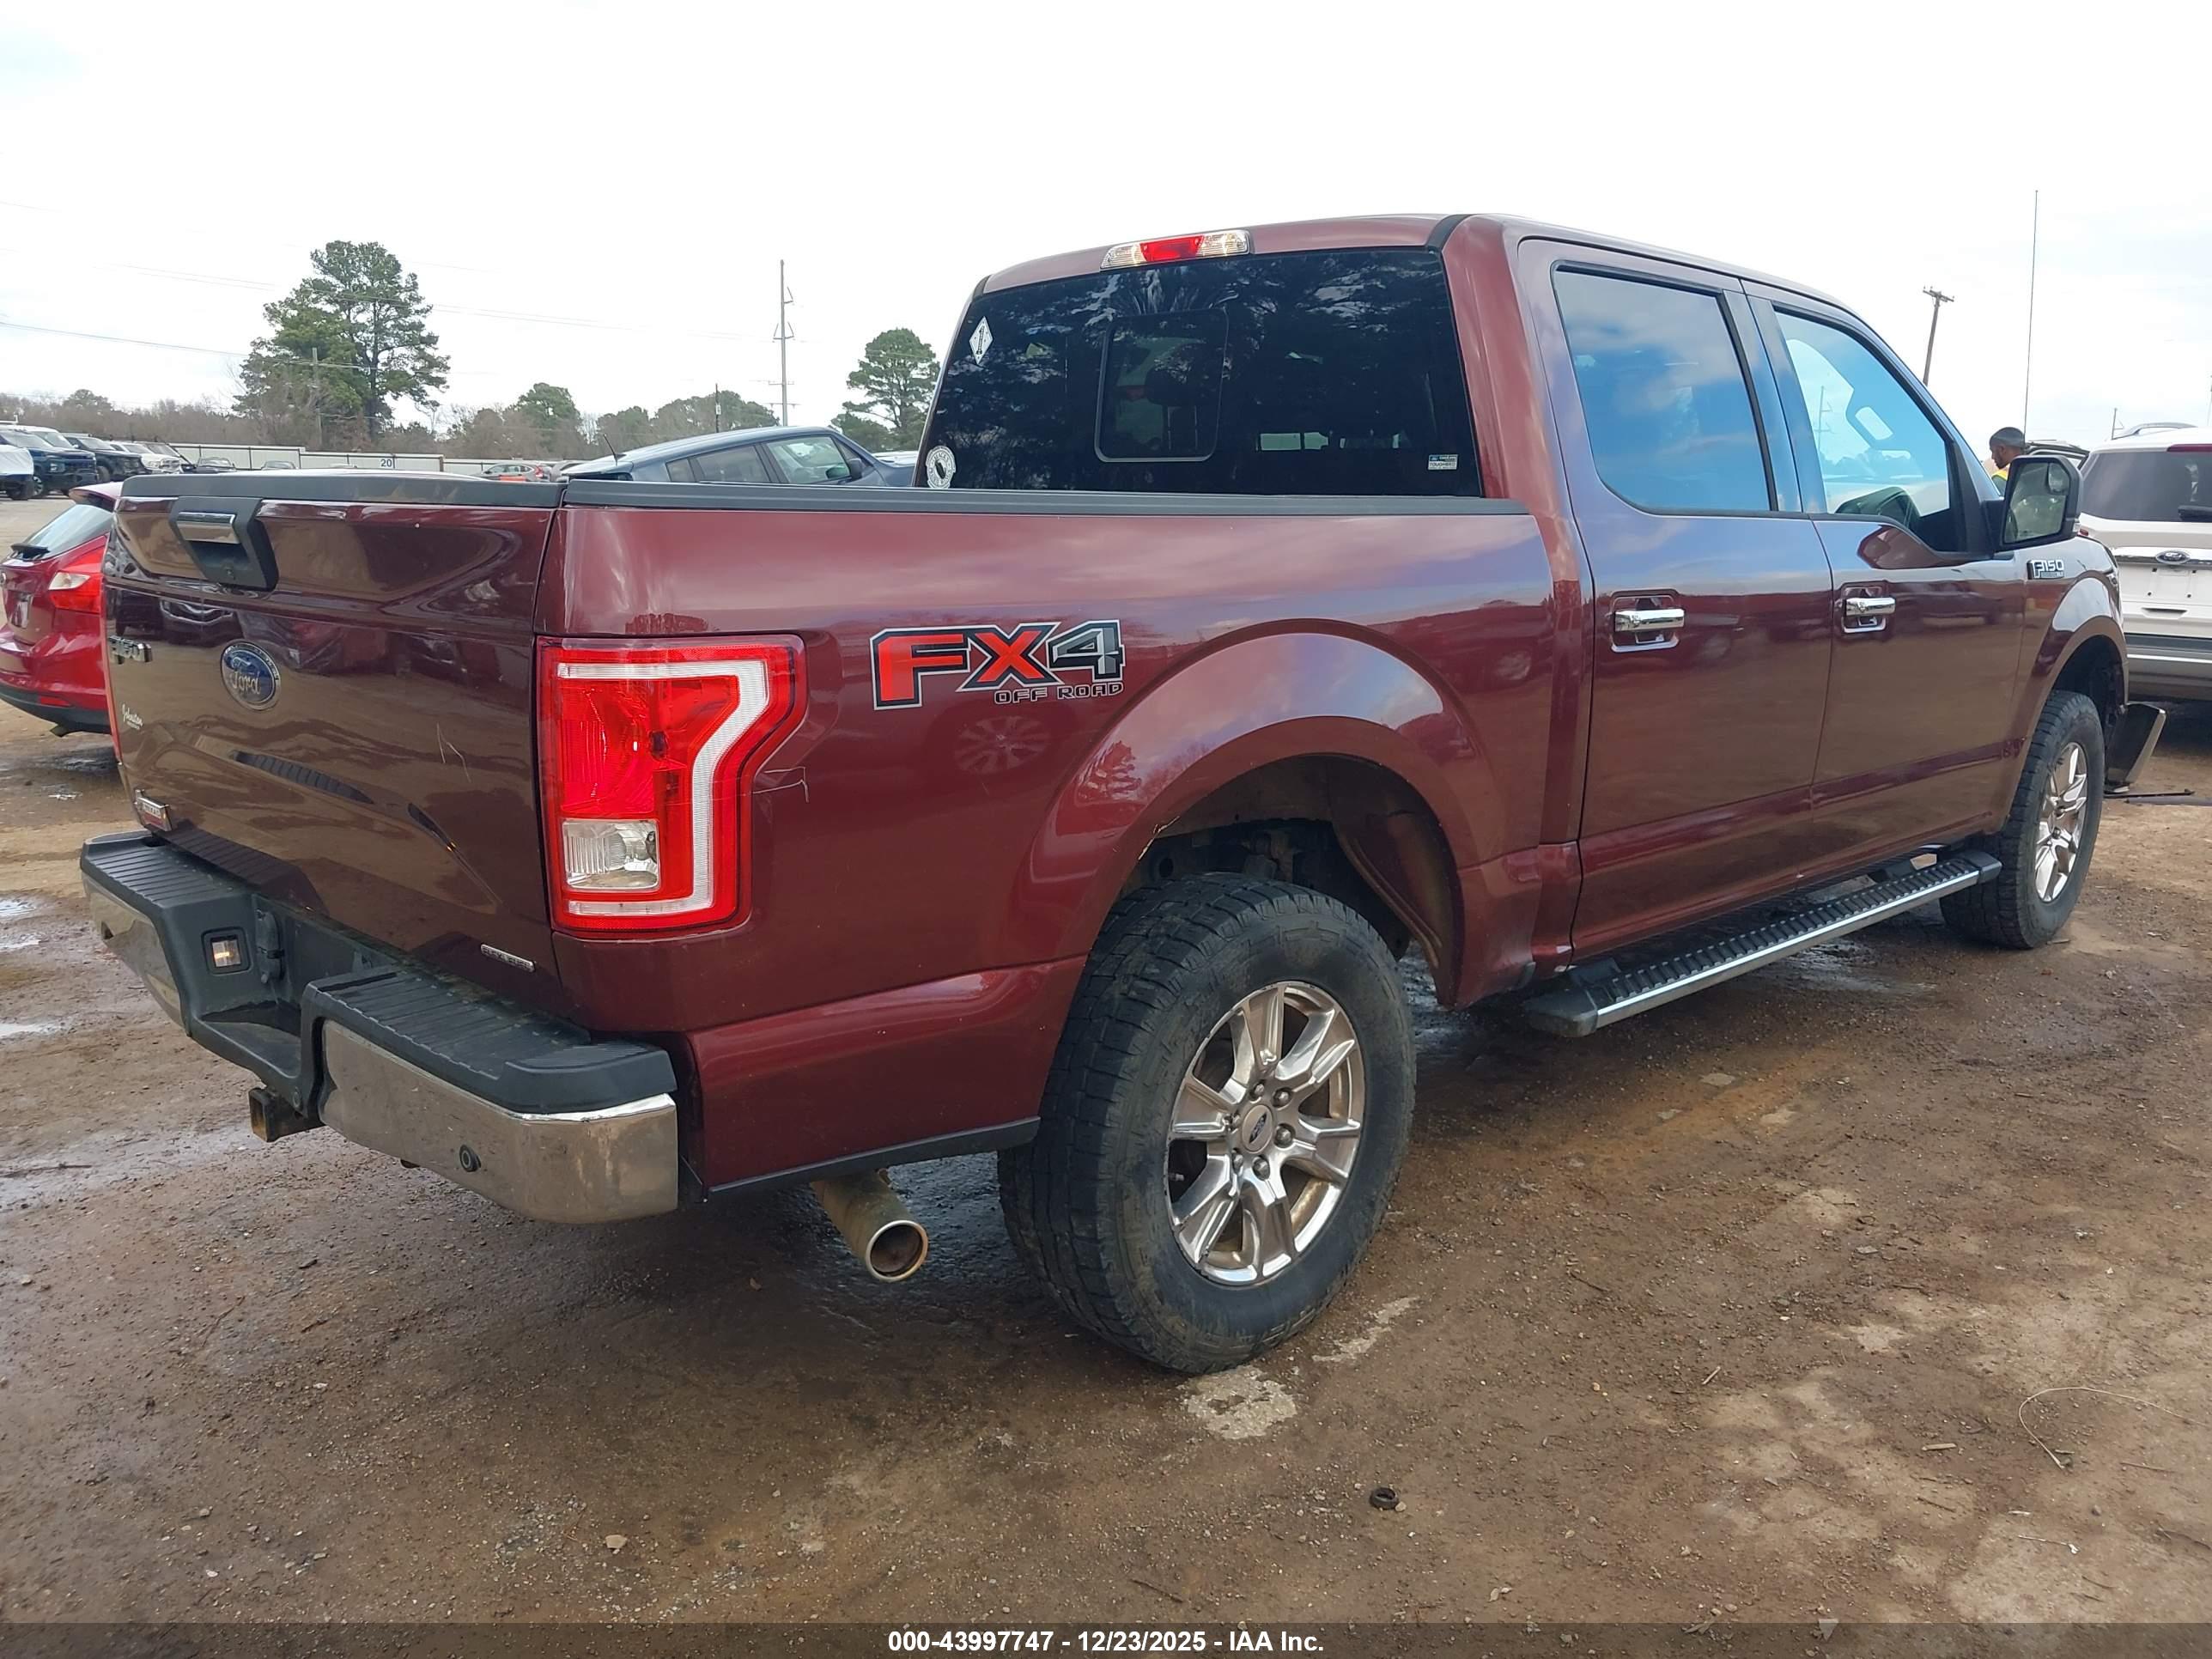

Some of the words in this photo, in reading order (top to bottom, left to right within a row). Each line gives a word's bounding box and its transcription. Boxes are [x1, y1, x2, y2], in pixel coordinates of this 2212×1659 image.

[380, 459, 392, 467] 20
[869, 619, 1126, 710] FX4
[994, 689, 1048, 705] OFF
[1057, 682, 1124, 700] ROAD
